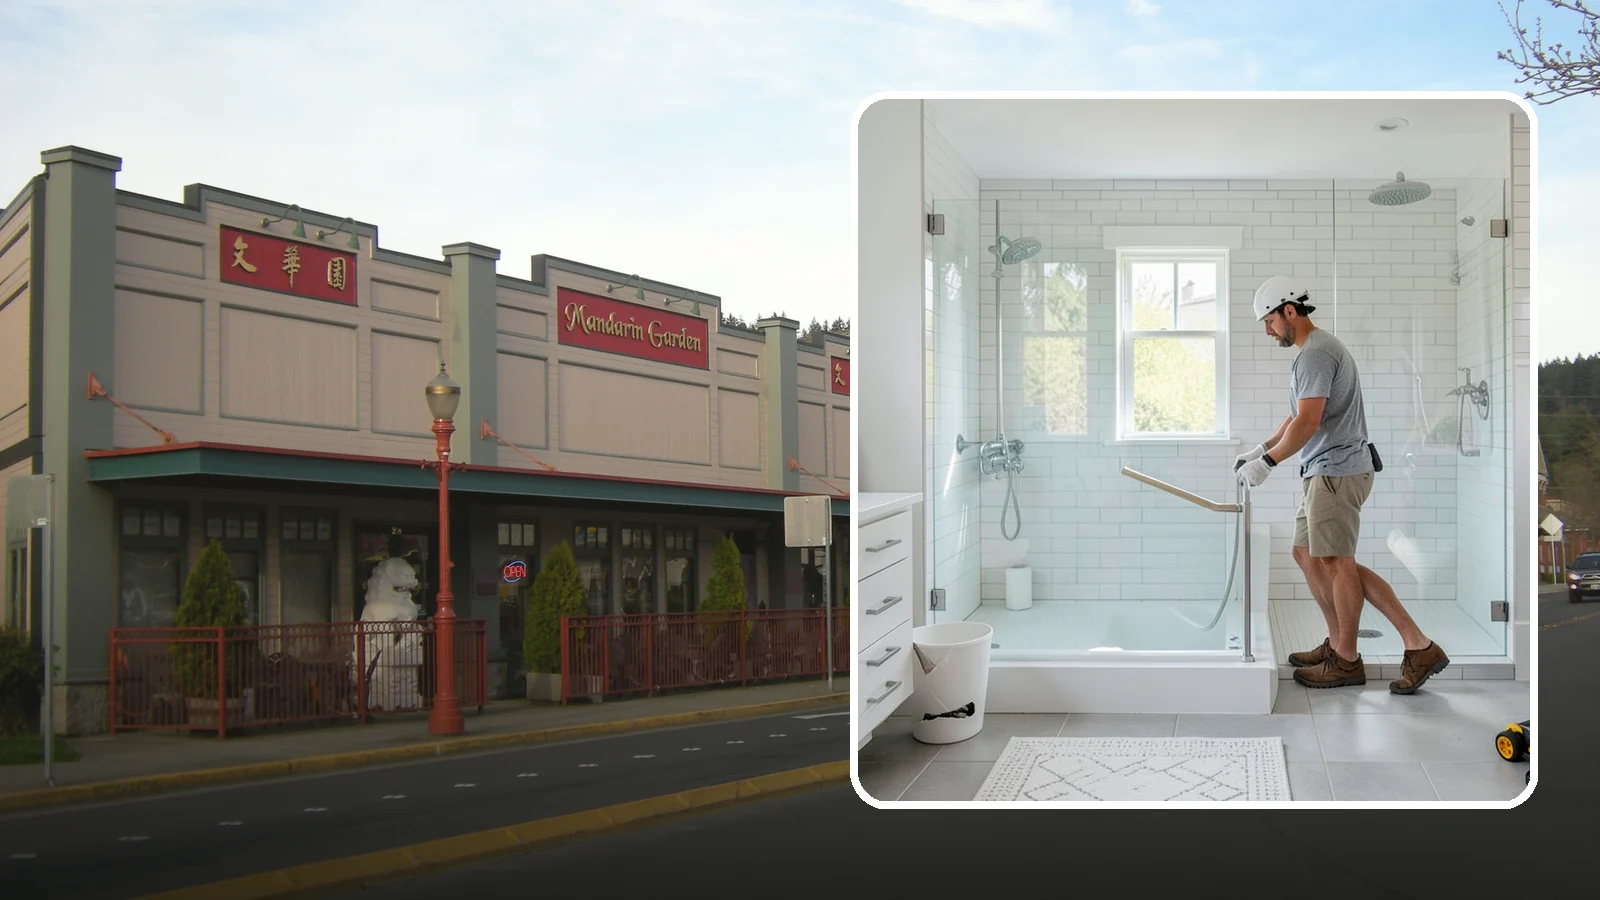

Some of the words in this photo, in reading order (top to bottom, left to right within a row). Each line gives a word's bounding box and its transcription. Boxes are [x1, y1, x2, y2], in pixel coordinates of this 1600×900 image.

[231, 236, 346, 291] 文華園
[565, 302, 644, 340] Mandarin
[648, 320, 701, 352] Garden
[503, 565, 526, 578] OPEN
